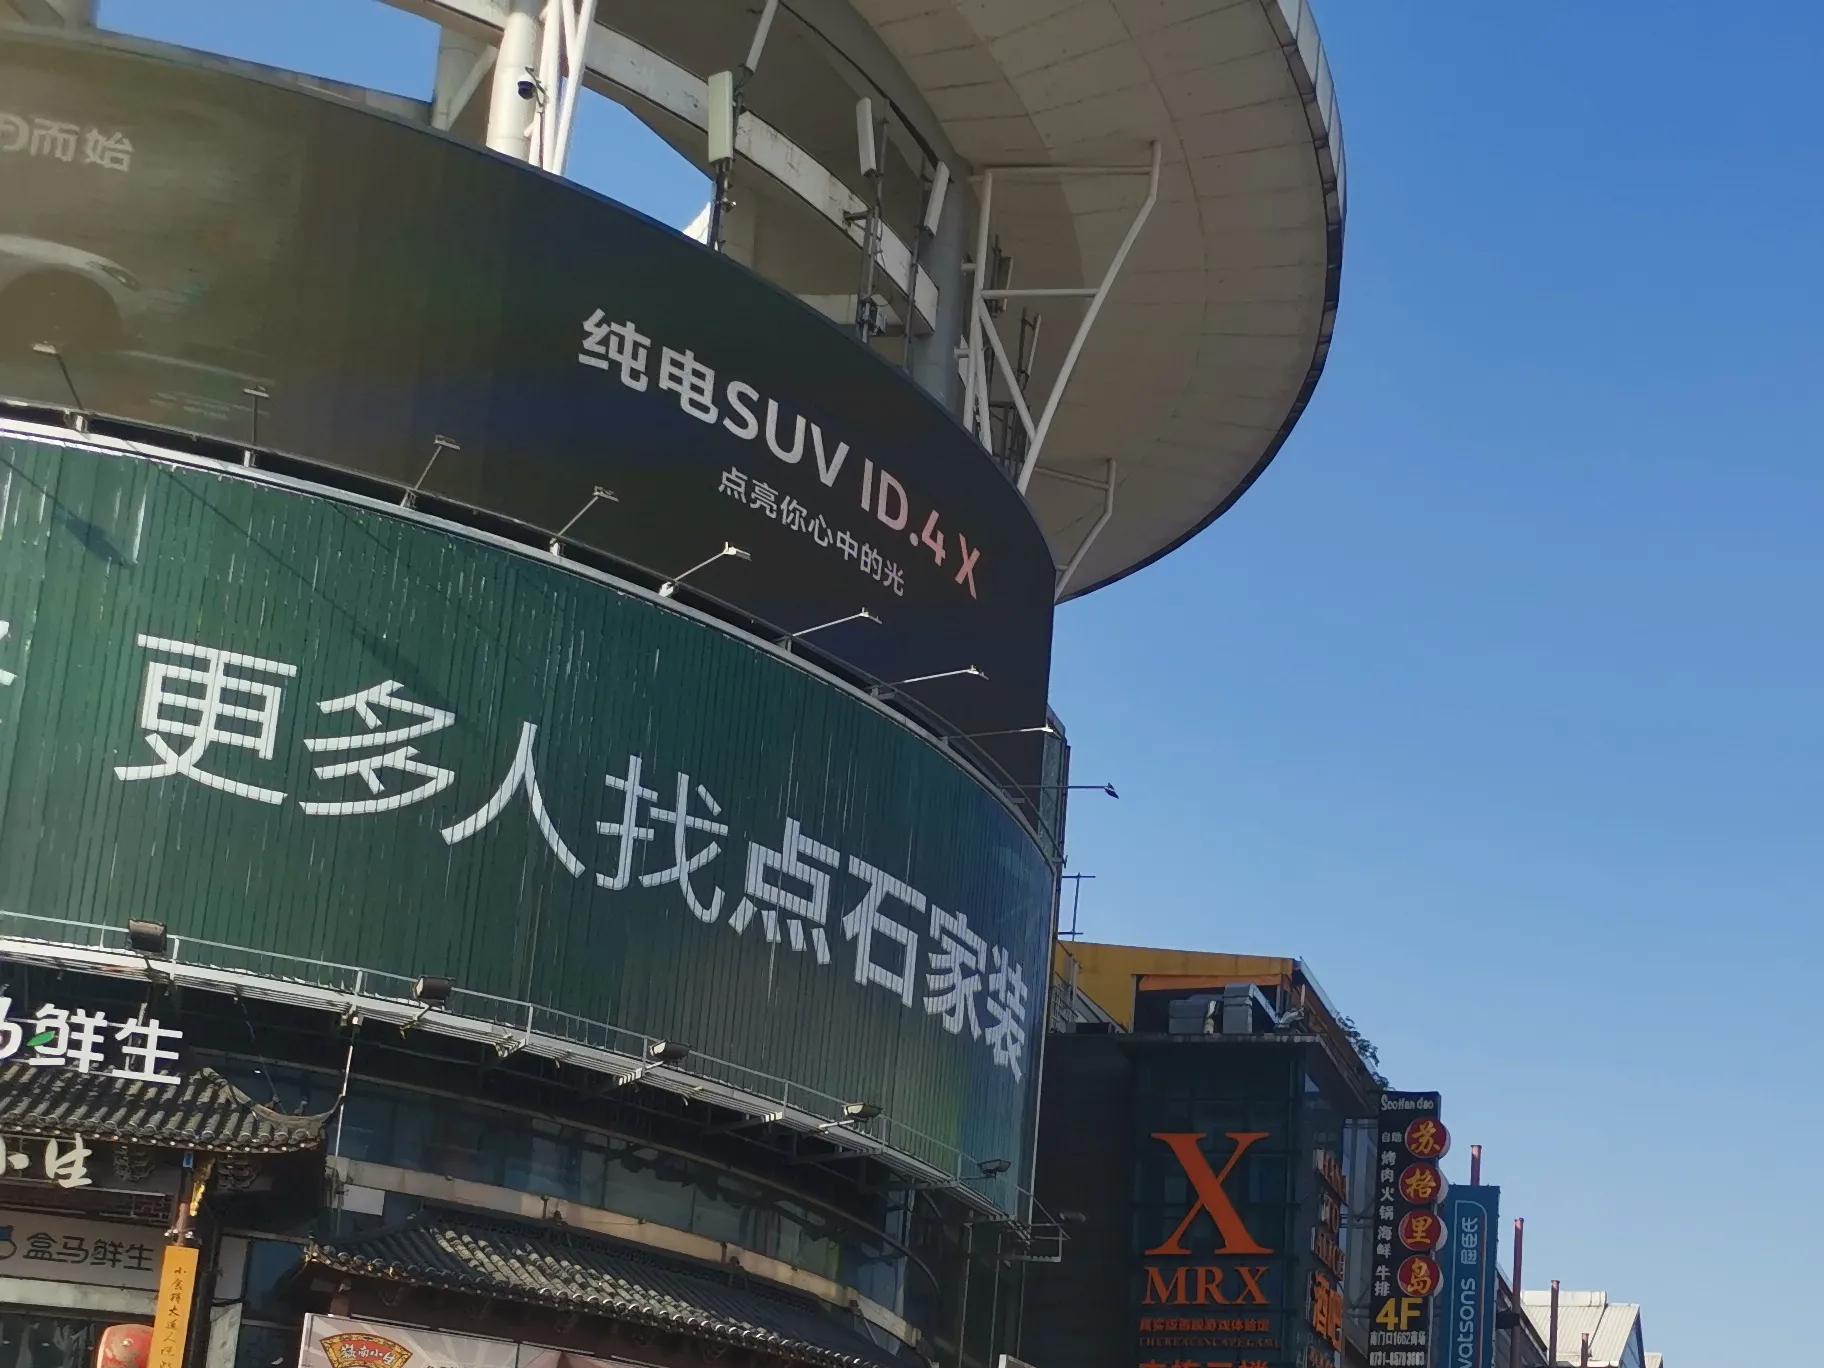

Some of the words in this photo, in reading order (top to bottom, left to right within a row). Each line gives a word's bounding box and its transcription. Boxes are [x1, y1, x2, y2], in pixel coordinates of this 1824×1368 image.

[717, 466, 905, 596] 点亮你心中的光
[114, 634, 1028, 1081] 更多人找点石家装
[1406, 1120, 1441, 1294] 苏格里岛
[23, 1232, 154, 1272] 盒马鲜生
[1460, 1217, 1480, 1265] 屈臣氏
[1142, 1266, 1271, 1306] MRX
[1376, 1298, 1423, 1331] 4F
